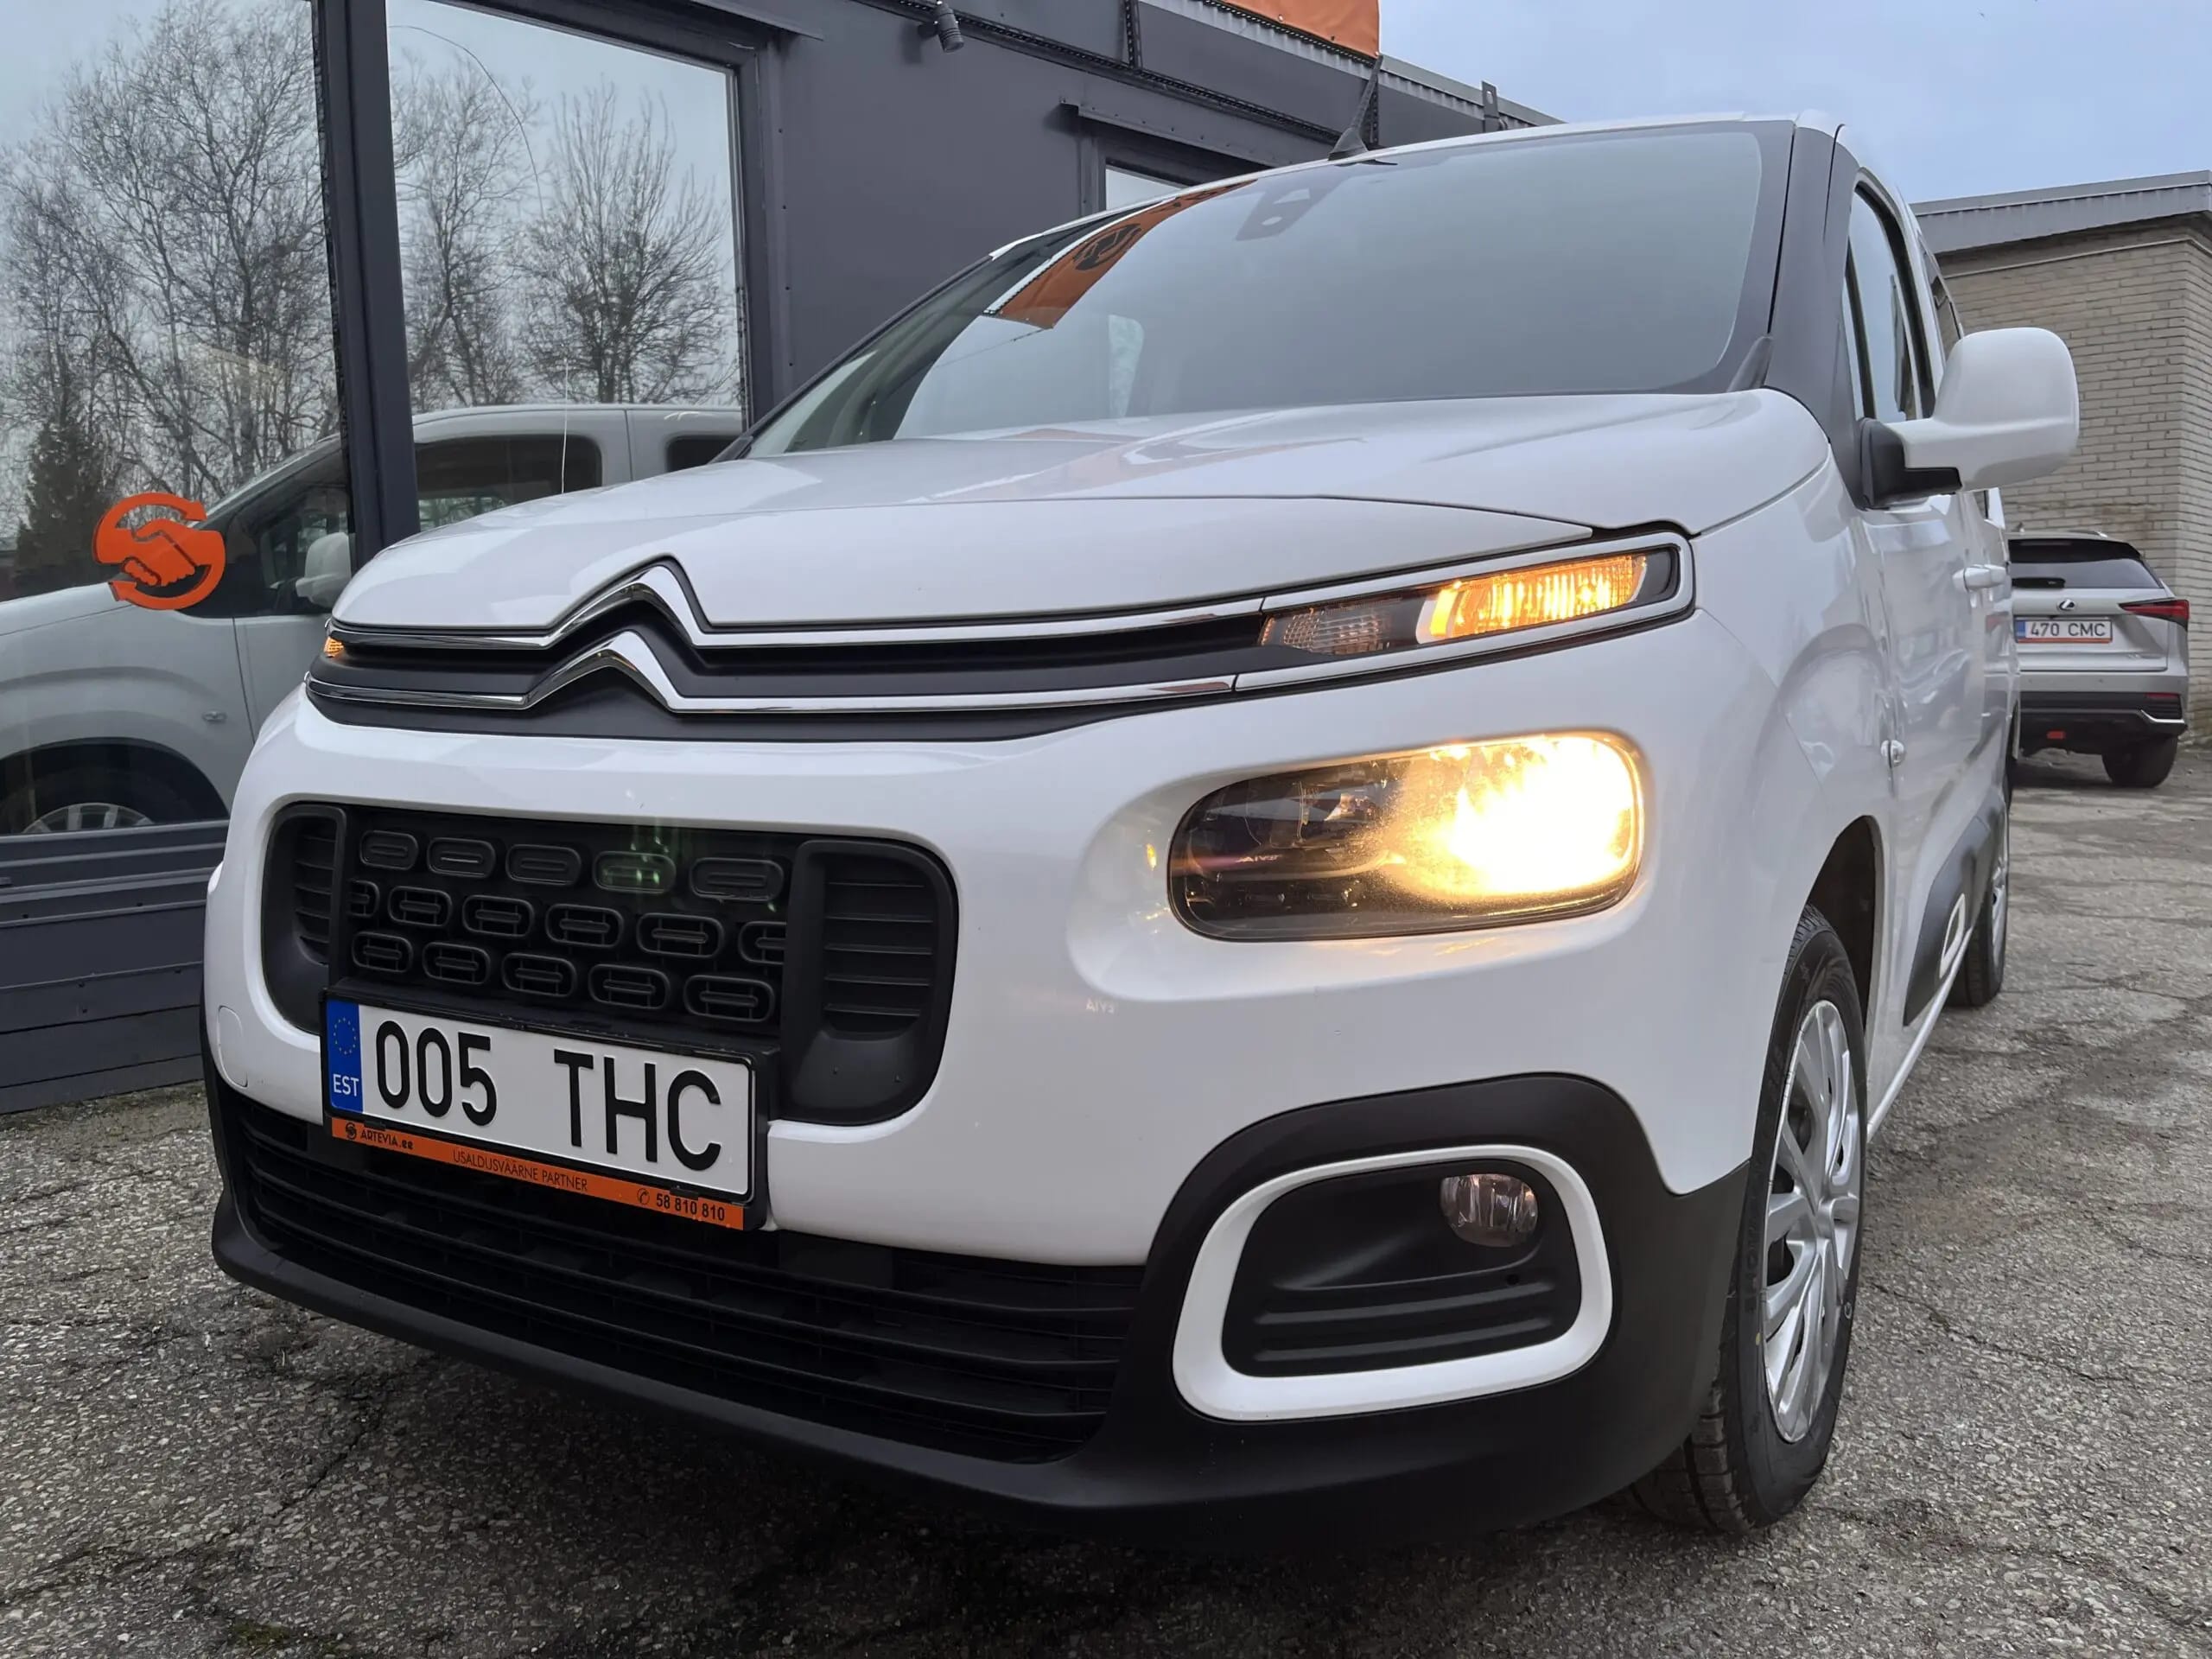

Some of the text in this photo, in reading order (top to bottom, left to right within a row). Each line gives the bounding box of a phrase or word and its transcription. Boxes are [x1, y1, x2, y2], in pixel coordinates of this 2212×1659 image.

[2031, 622, 2106, 637] 470 CMC
[334, 1074, 359, 1097] EST
[376, 1020, 722, 1172] 005 THC
[360, 1128, 414, 1150] ARTEVIA.ee
[452, 1149, 588, 1192] USALDUSVÄÄRNE PARTNER
[656, 1193, 725, 1221] 58 810 810
